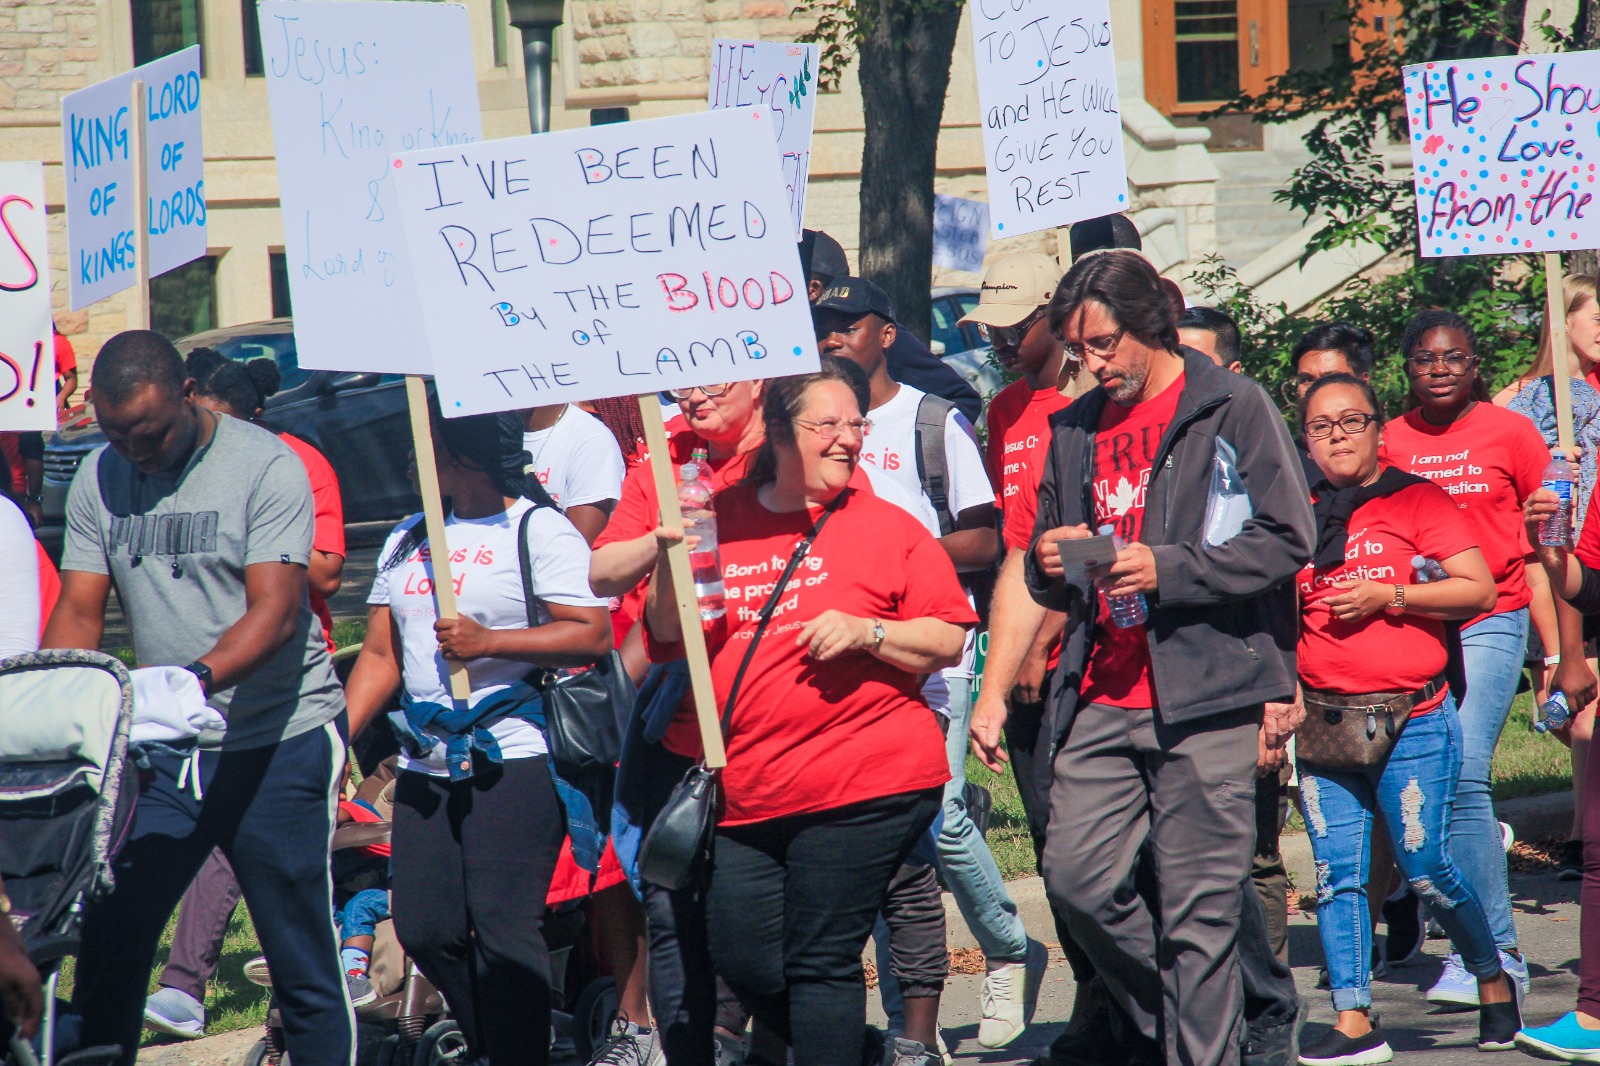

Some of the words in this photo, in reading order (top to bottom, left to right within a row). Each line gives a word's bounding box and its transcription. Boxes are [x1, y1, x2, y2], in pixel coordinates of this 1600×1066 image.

[272, 14, 379, 85] Jesus:
[979, 31, 1015, 63] TO
[1018, 16, 1112, 85] JESUS
[149, 71, 200, 121] LORD
[988, 93, 1030, 129] and
[1042, 78, 1077, 119] HE
[1083, 77, 1119, 114] WILL
[1422, 67, 1482, 130] He
[71, 106, 128, 170] KING
[161, 141, 184, 172] OF
[1068, 126, 1114, 161] YOU
[1498, 124, 1583, 162] Love.
[418, 155, 529, 211] I'VE
[575, 138, 719, 185] BEEN
[1010, 171, 1091, 213] REST
[1529, 169, 1592, 225] the
[90, 182, 117, 216] OF
[149, 180, 206, 235] LORDS
[81, 229, 135, 286] KINGS
[439, 200, 767, 292] REDEEMED
[491, 301, 547, 330] By
[553, 282, 640, 313] THE
[572, 319, 612, 346] of
[483, 362, 579, 398] THE
[616, 330, 768, 378] LAMB
[1411, 454, 1417, 465] I
[1418, 455, 1442, 464] am
[1445, 449, 1470, 463] not
[1468, 464, 1483, 475] to
[109, 511, 219, 557] PUMA
[473, 544, 494, 565] is
[1364, 540, 1384, 555] to
[724, 562, 768, 578] Born
[771, 555, 787, 571] to
[805, 572, 828, 587] of
[1301, 581, 1313, 592] a
